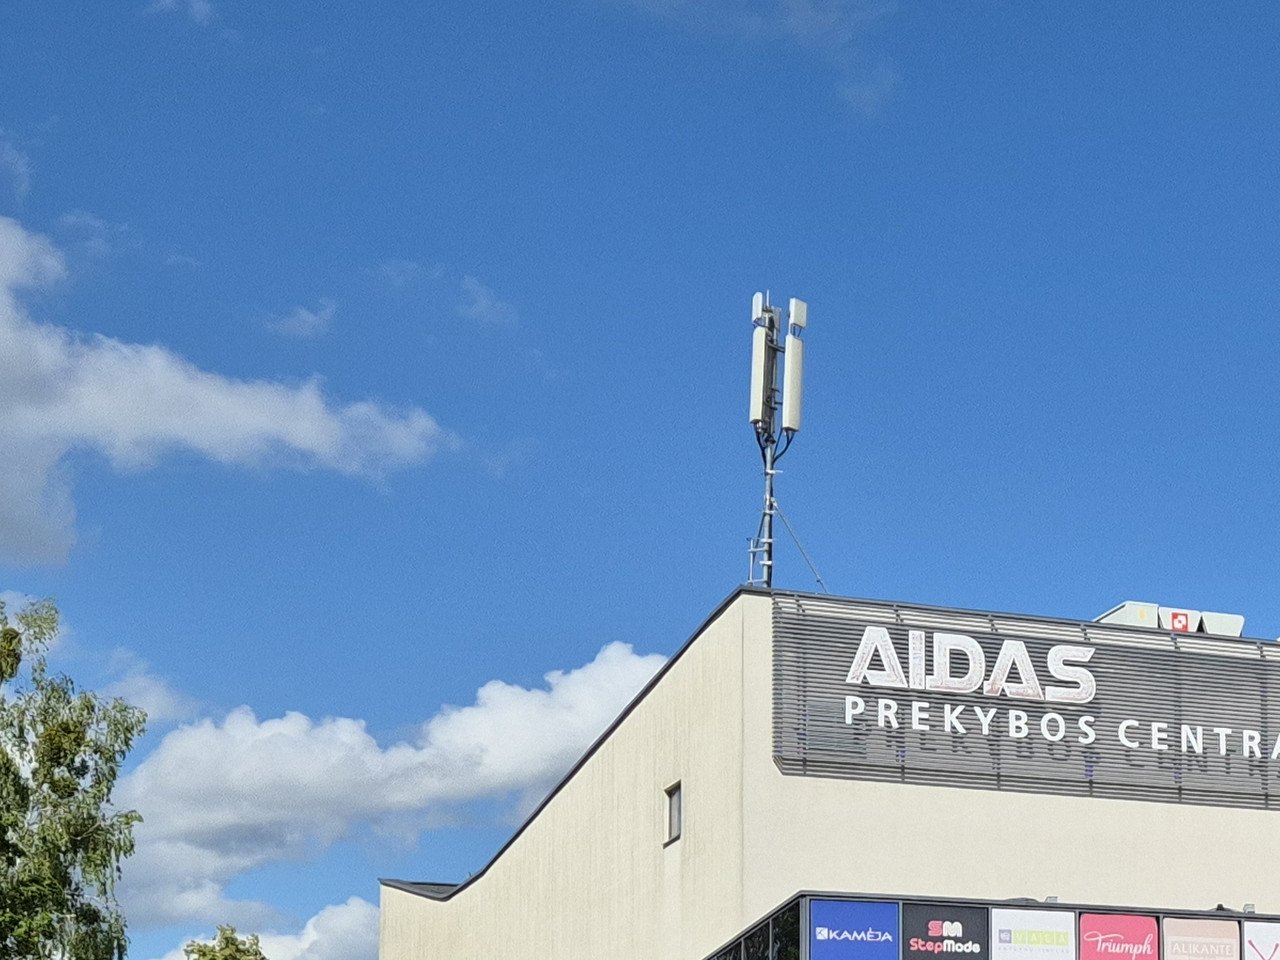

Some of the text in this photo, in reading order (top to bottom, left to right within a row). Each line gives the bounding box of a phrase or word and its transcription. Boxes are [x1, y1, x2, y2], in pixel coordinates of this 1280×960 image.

[845, 625, 1097, 704] AIDAS
[845, 695, 1097, 745] PREKYBOS
[927, 920, 963, 938] SM
[909, 938, 981, 955] StepMode
[1172, 942, 1233, 957] ALIKANTE
